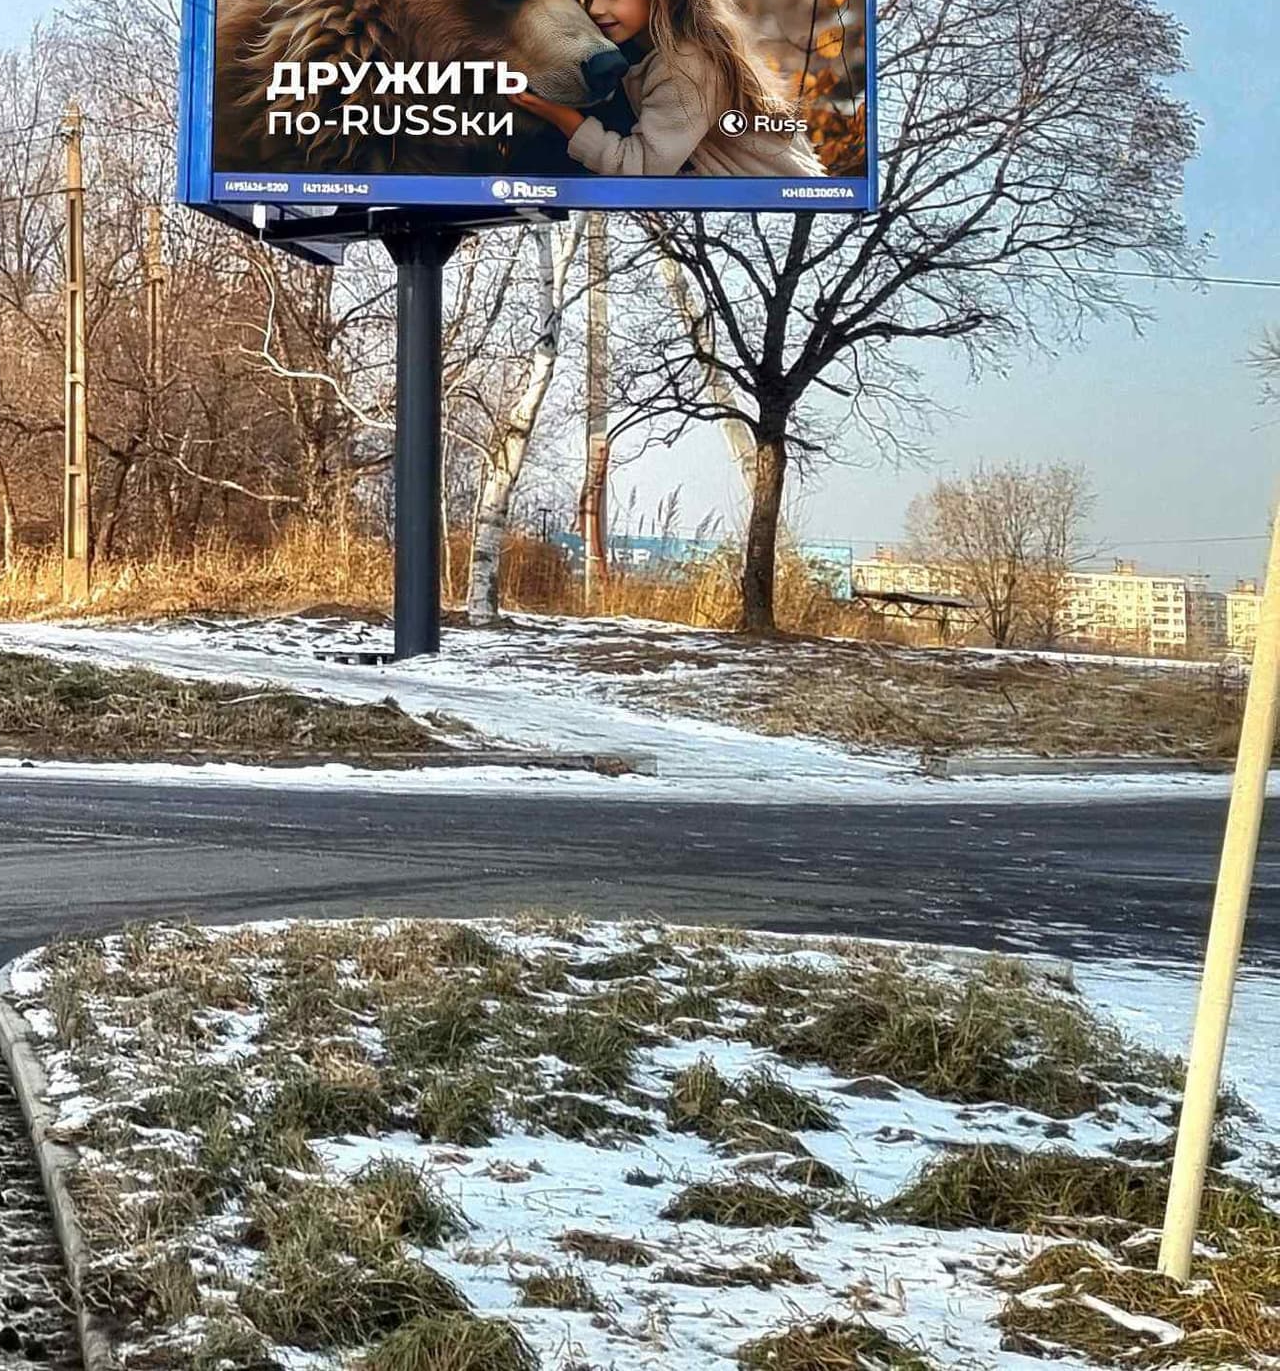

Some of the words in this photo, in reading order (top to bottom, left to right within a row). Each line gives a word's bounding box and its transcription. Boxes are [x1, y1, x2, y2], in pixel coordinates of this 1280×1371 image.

[266, 61, 529, 101] ДРУЖИТЬ
[268, 104, 514, 136] по-RUSSки
[754, 115, 808, 132] Russ
[513, 181, 558, 198] Russ
